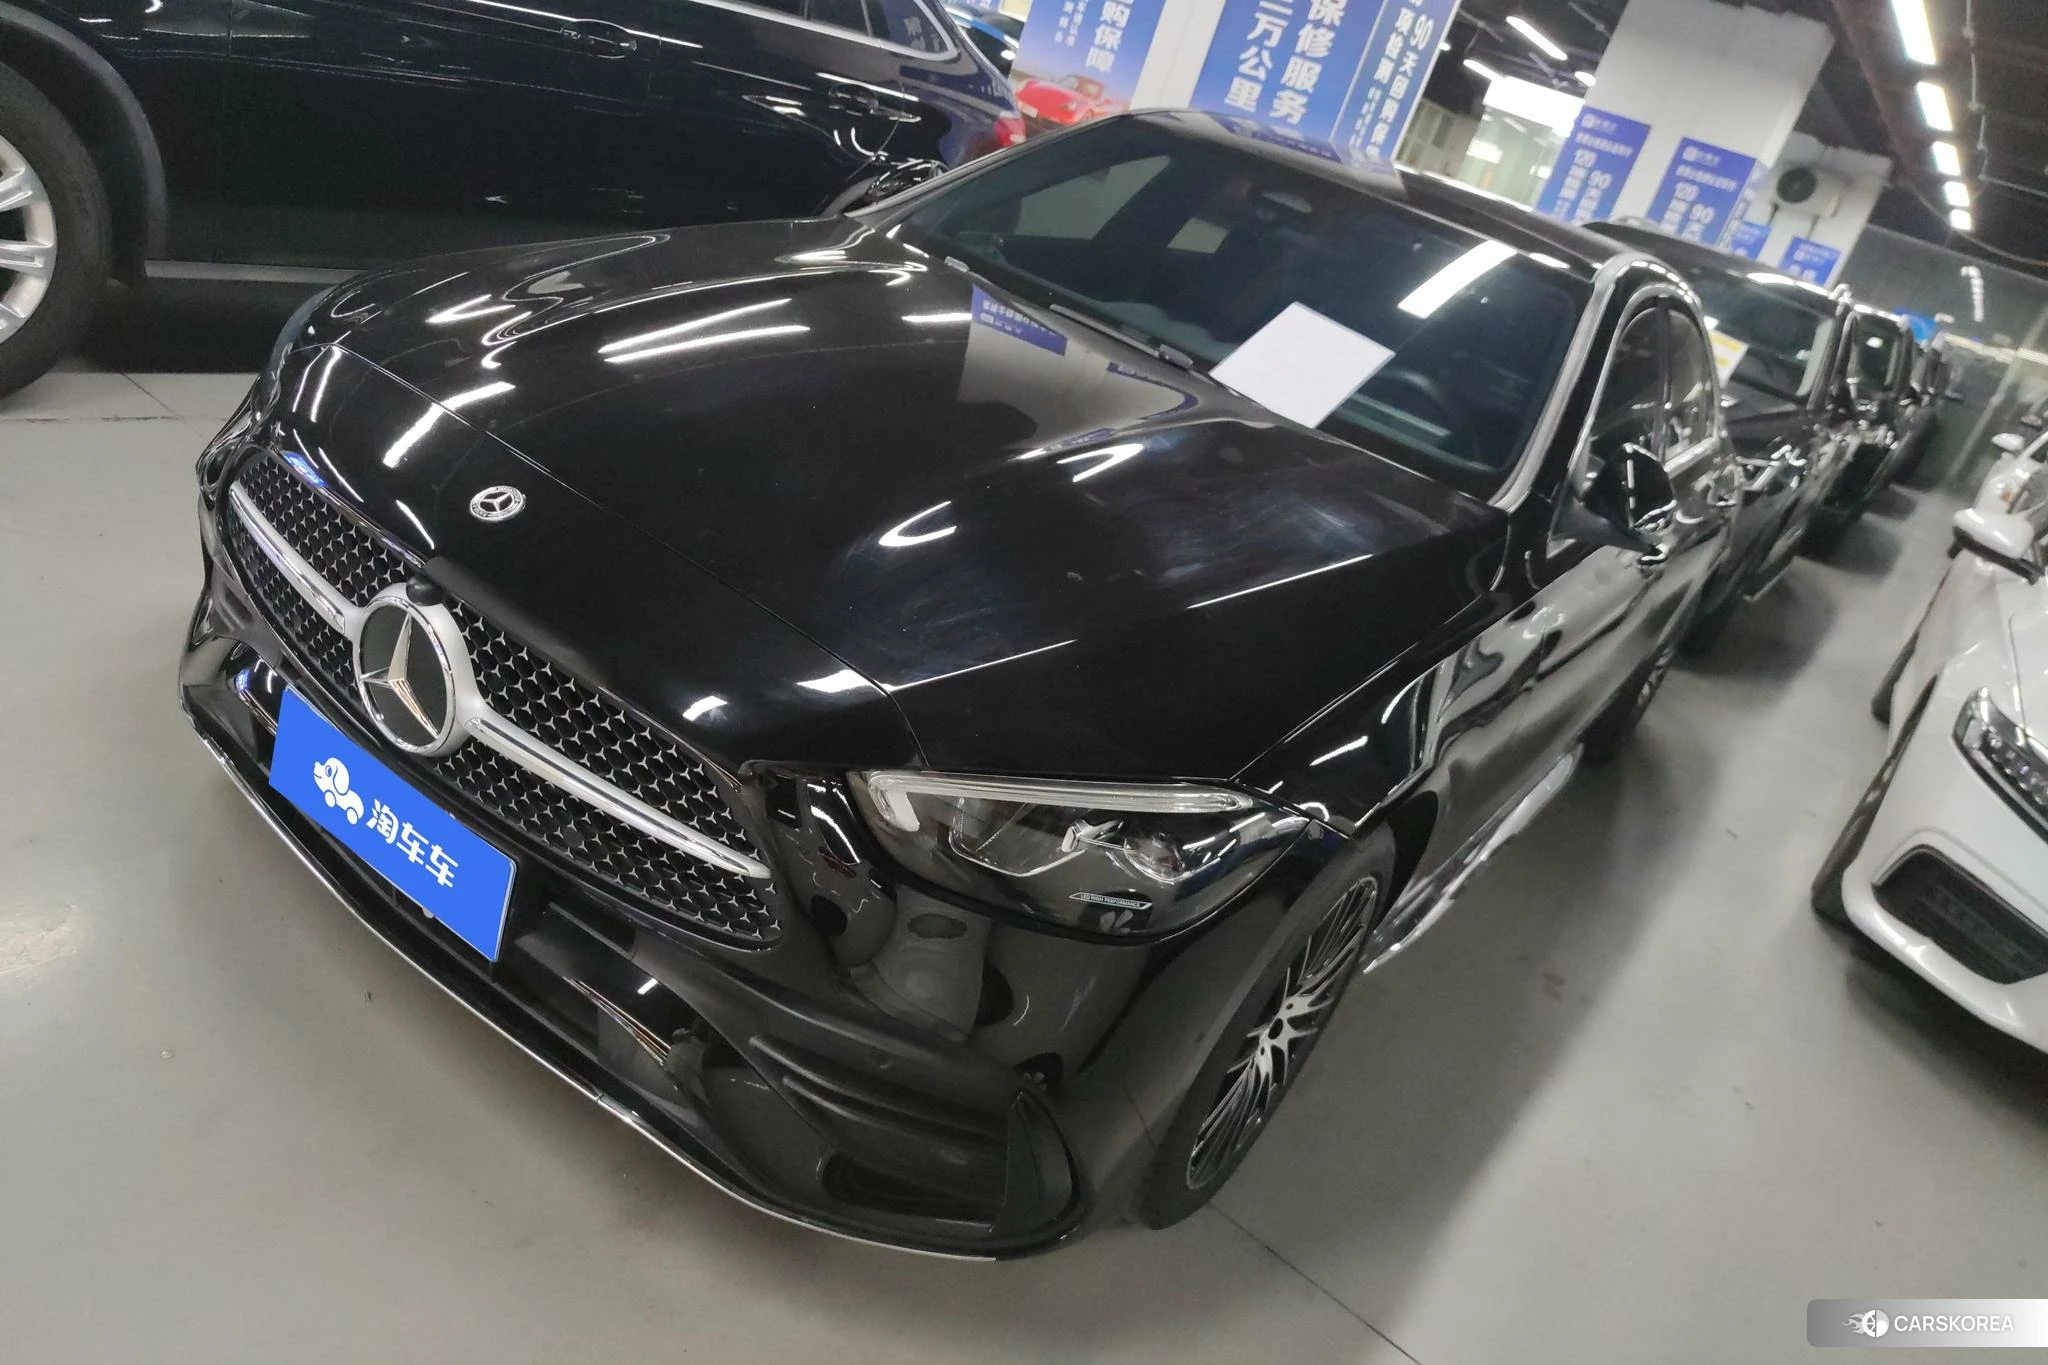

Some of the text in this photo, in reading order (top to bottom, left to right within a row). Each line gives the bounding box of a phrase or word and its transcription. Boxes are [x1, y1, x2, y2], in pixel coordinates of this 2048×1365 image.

[1085, 0, 1135, 73] 购保障
[1269, 0, 1348, 125] 保修服务
[1104, 897, 1141, 908] PERFORMANCE
